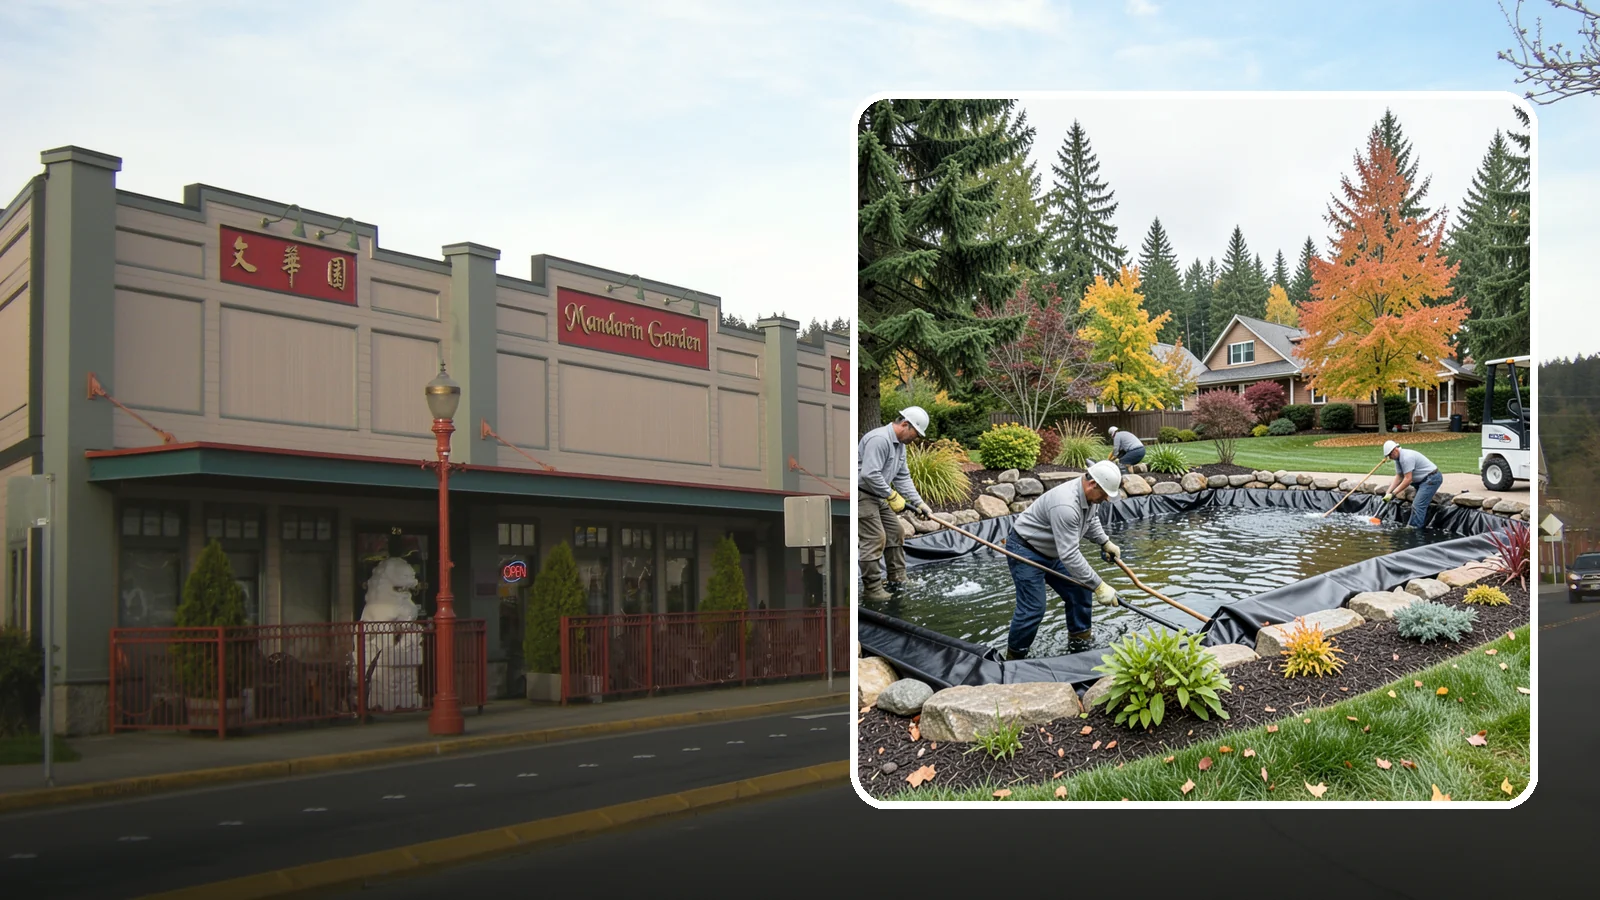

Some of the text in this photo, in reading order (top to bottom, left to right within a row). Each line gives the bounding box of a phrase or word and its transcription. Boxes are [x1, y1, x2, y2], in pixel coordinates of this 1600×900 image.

[231, 236, 346, 291] 文華園
[564, 302, 701, 351] Mandarin Garden
[503, 565, 527, 578] OPEN
